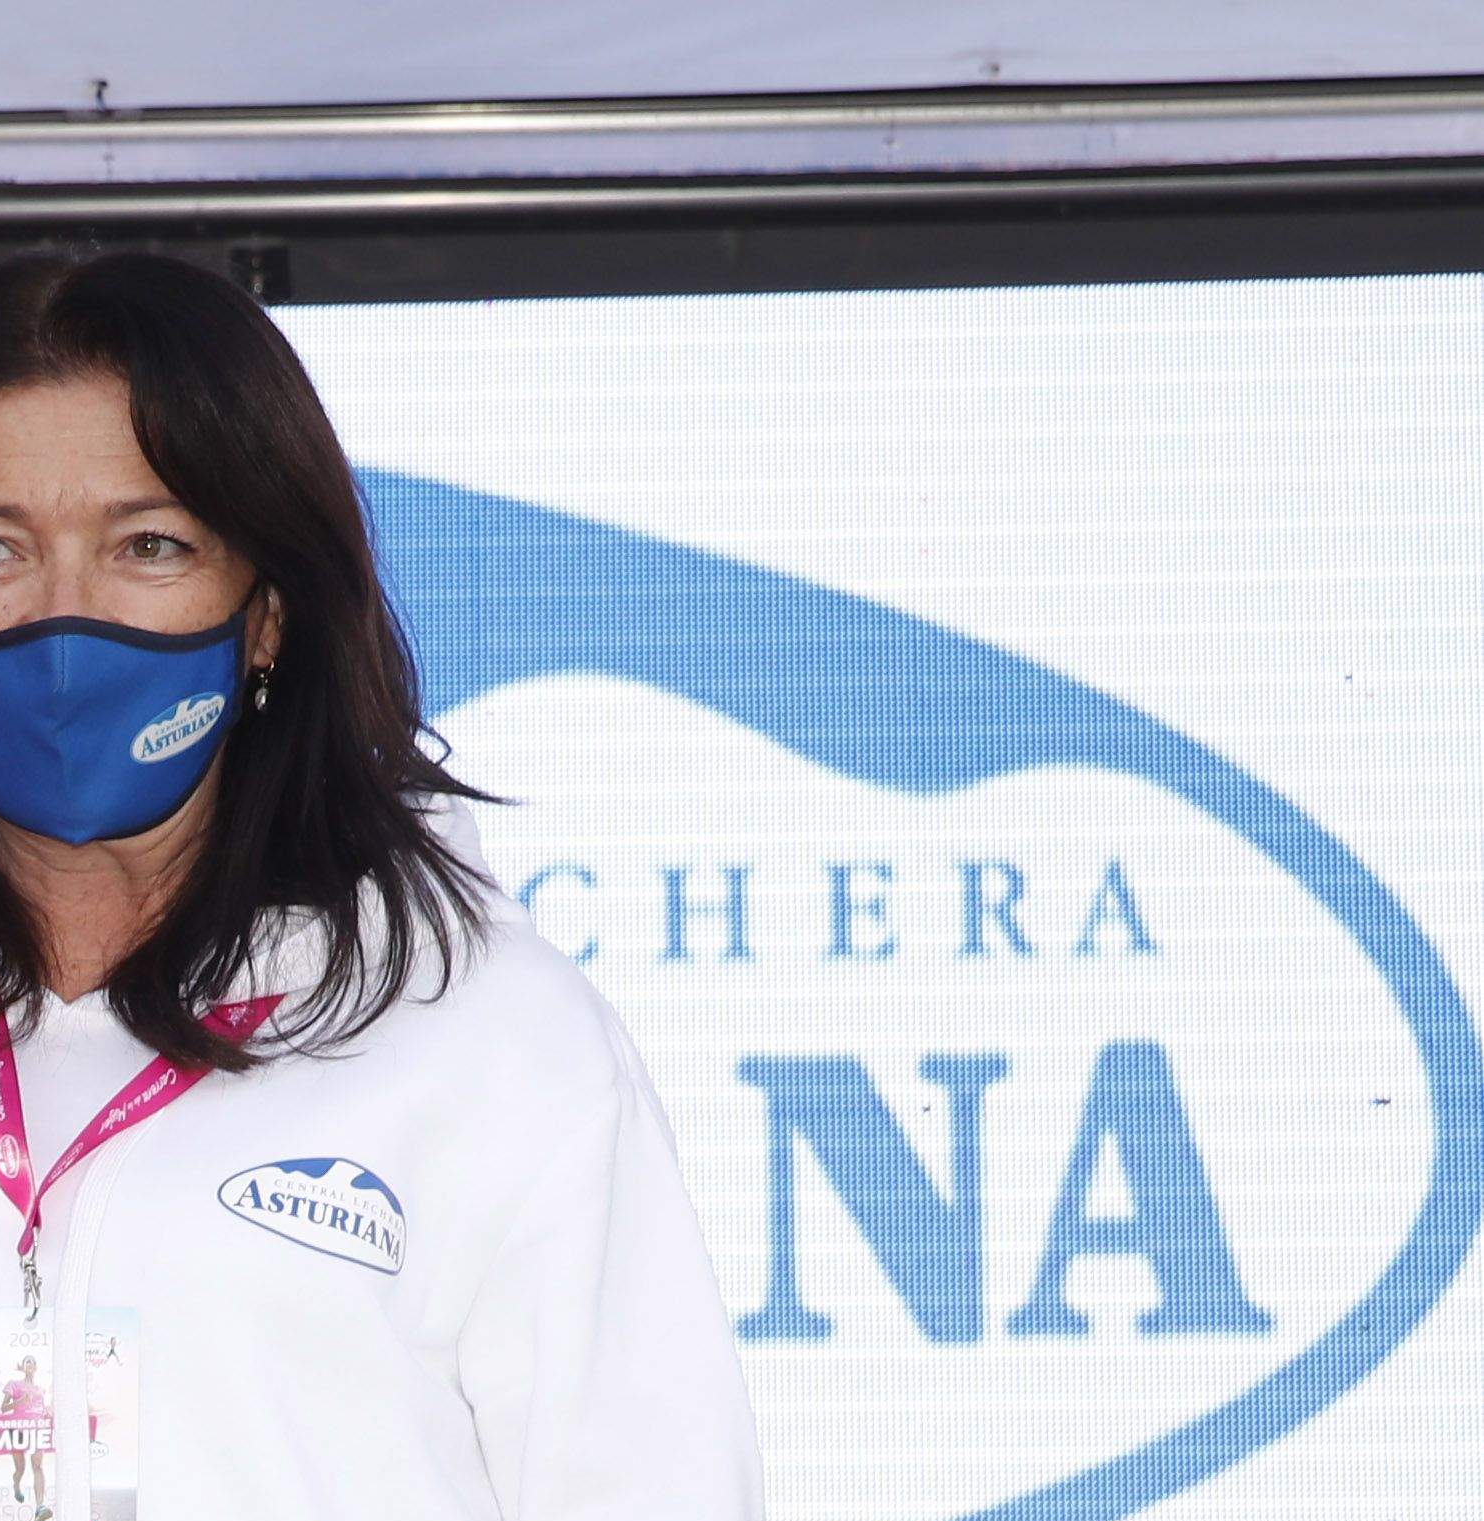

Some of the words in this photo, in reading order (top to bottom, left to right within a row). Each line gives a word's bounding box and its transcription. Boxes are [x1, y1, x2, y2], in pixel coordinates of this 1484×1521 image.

[140, 705, 220, 759] ASTURIANA
[516, 857, 1160, 966] CHERA
[274, 1178, 346, 1201] CENTRAL
[233, 1178, 400, 1266] ASTURIANA
[9, 1332, 49, 1347] 2021
